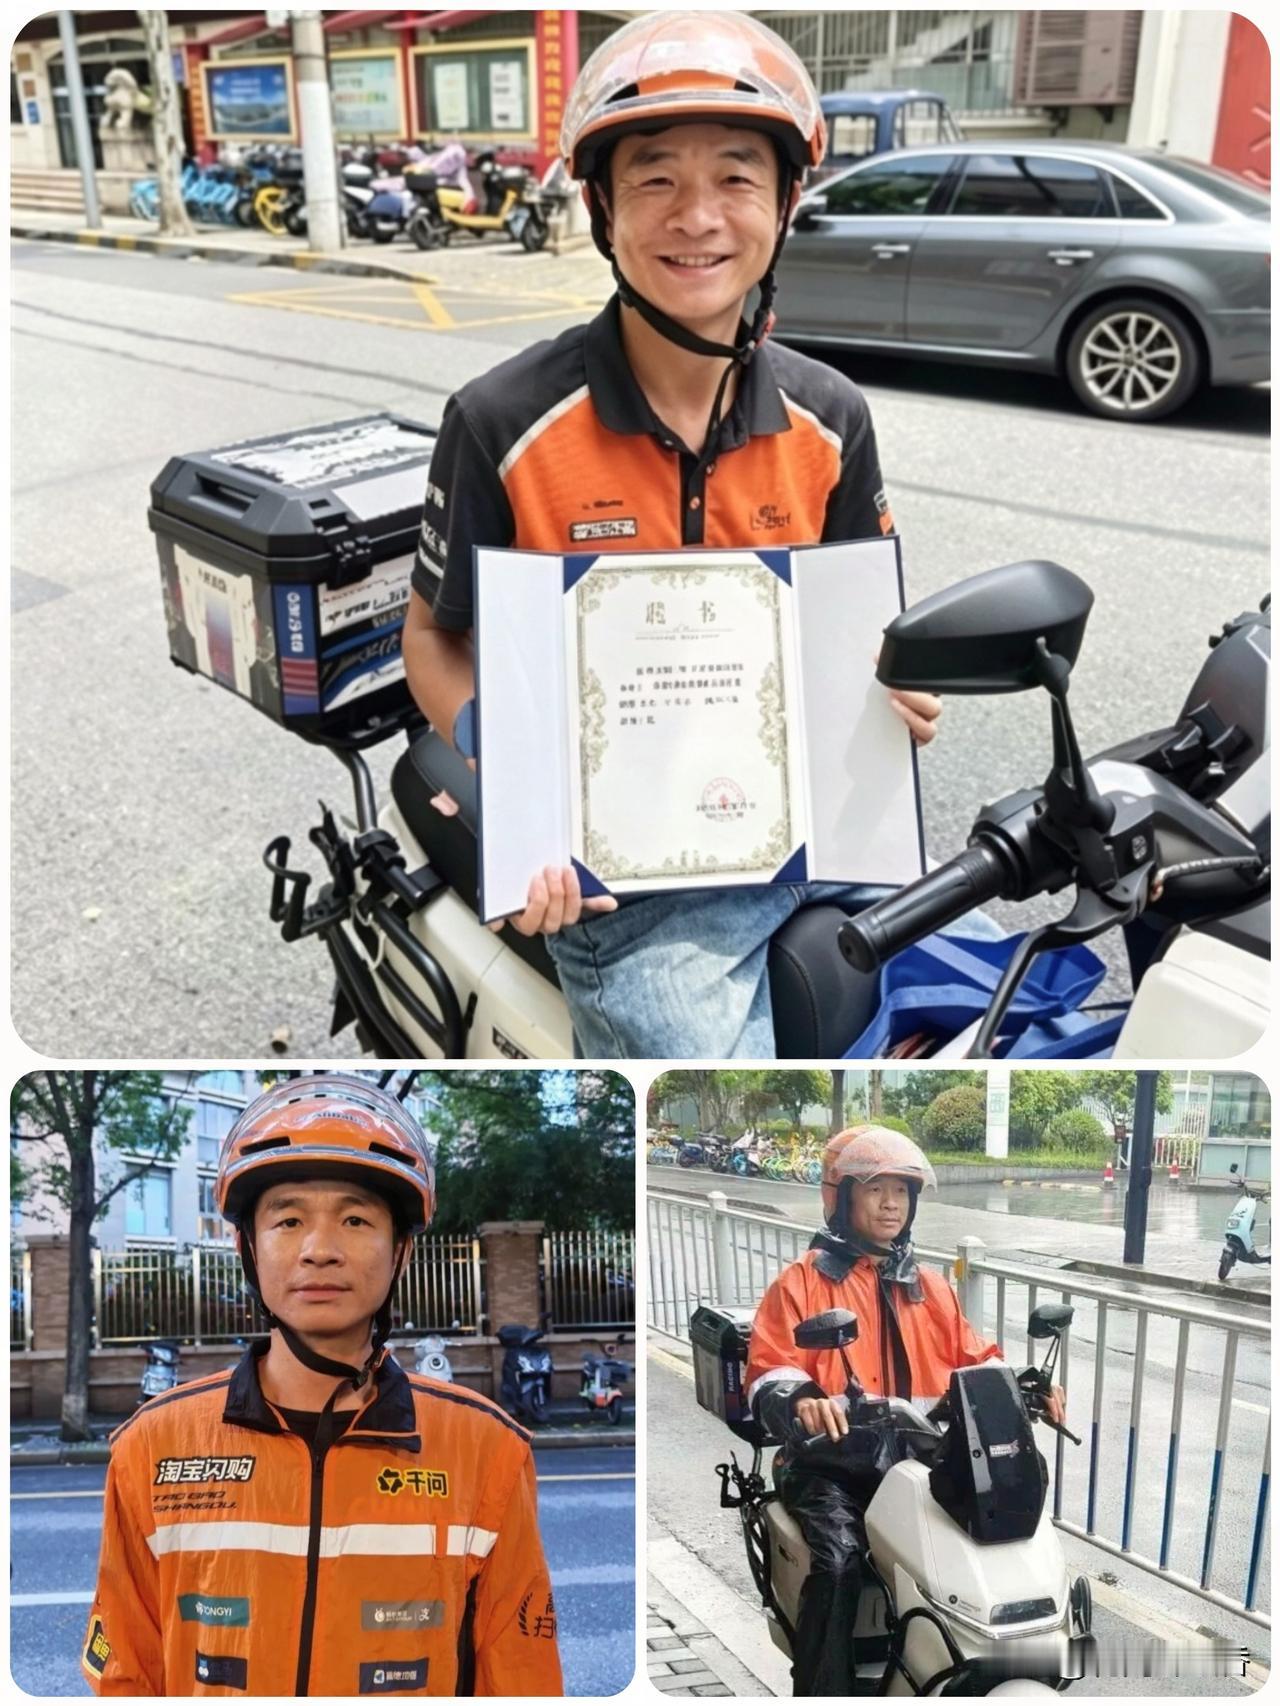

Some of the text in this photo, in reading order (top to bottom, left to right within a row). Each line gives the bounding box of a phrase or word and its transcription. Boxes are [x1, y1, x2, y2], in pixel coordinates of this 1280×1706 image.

[156, 1457, 253, 1484] 淘宝闪购
[406, 1469, 447, 1495] 千问
